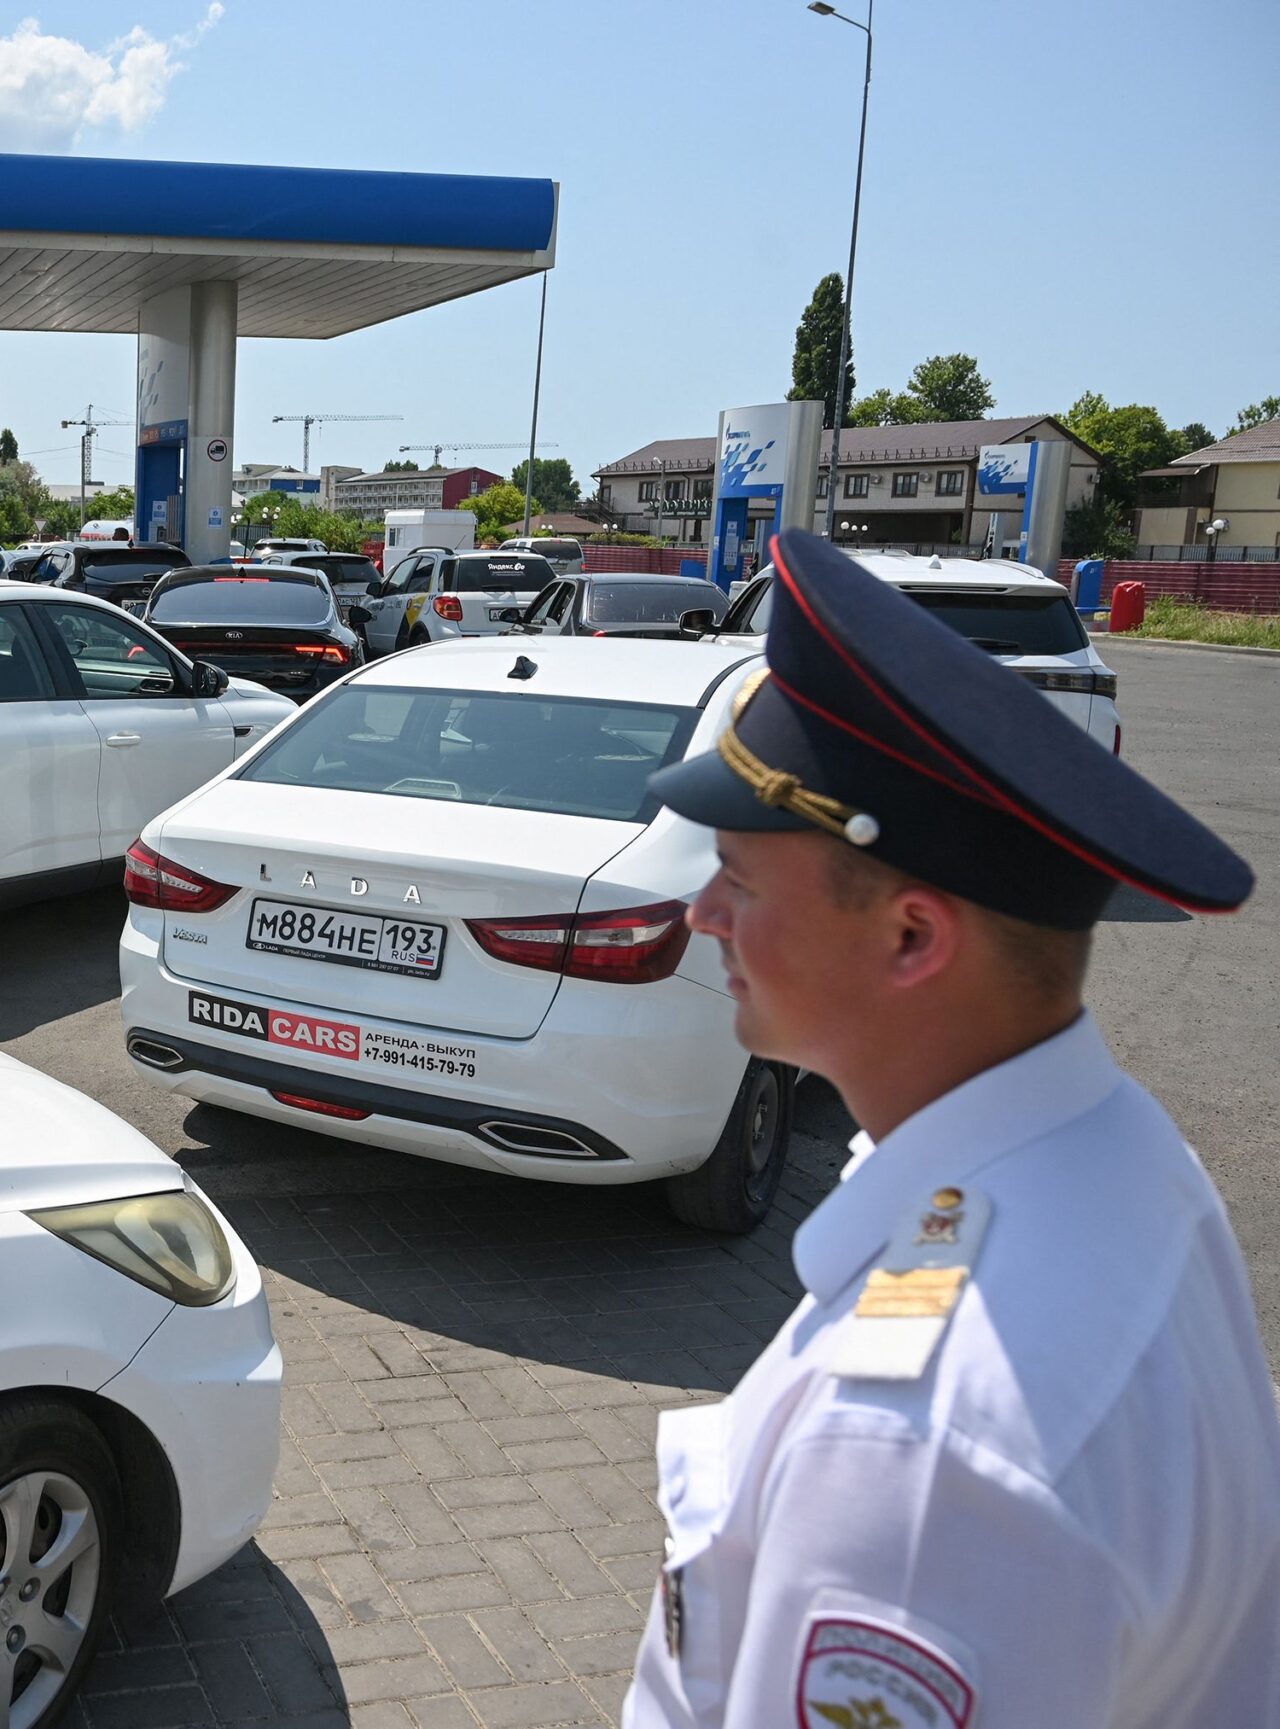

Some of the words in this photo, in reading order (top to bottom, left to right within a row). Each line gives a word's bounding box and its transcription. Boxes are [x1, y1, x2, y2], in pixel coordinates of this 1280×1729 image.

[227, 631, 241, 639] KIA
[259, 863, 422, 905] LADA
[172, 928, 208, 945] VESTA
[258, 910, 377, 955] М884НЕ
[384, 924, 435, 954] 193
[391, 950, 416, 963] RUS
[193, 998, 265, 1034] RIDA
[272, 1018, 357, 1052] CARS
[365, 1033, 419, 1050] АРЕНДА
[427, 1043, 476, 1059] ВЫКУП
[364, 1047, 476, 1078] +7-991-415-79-79
